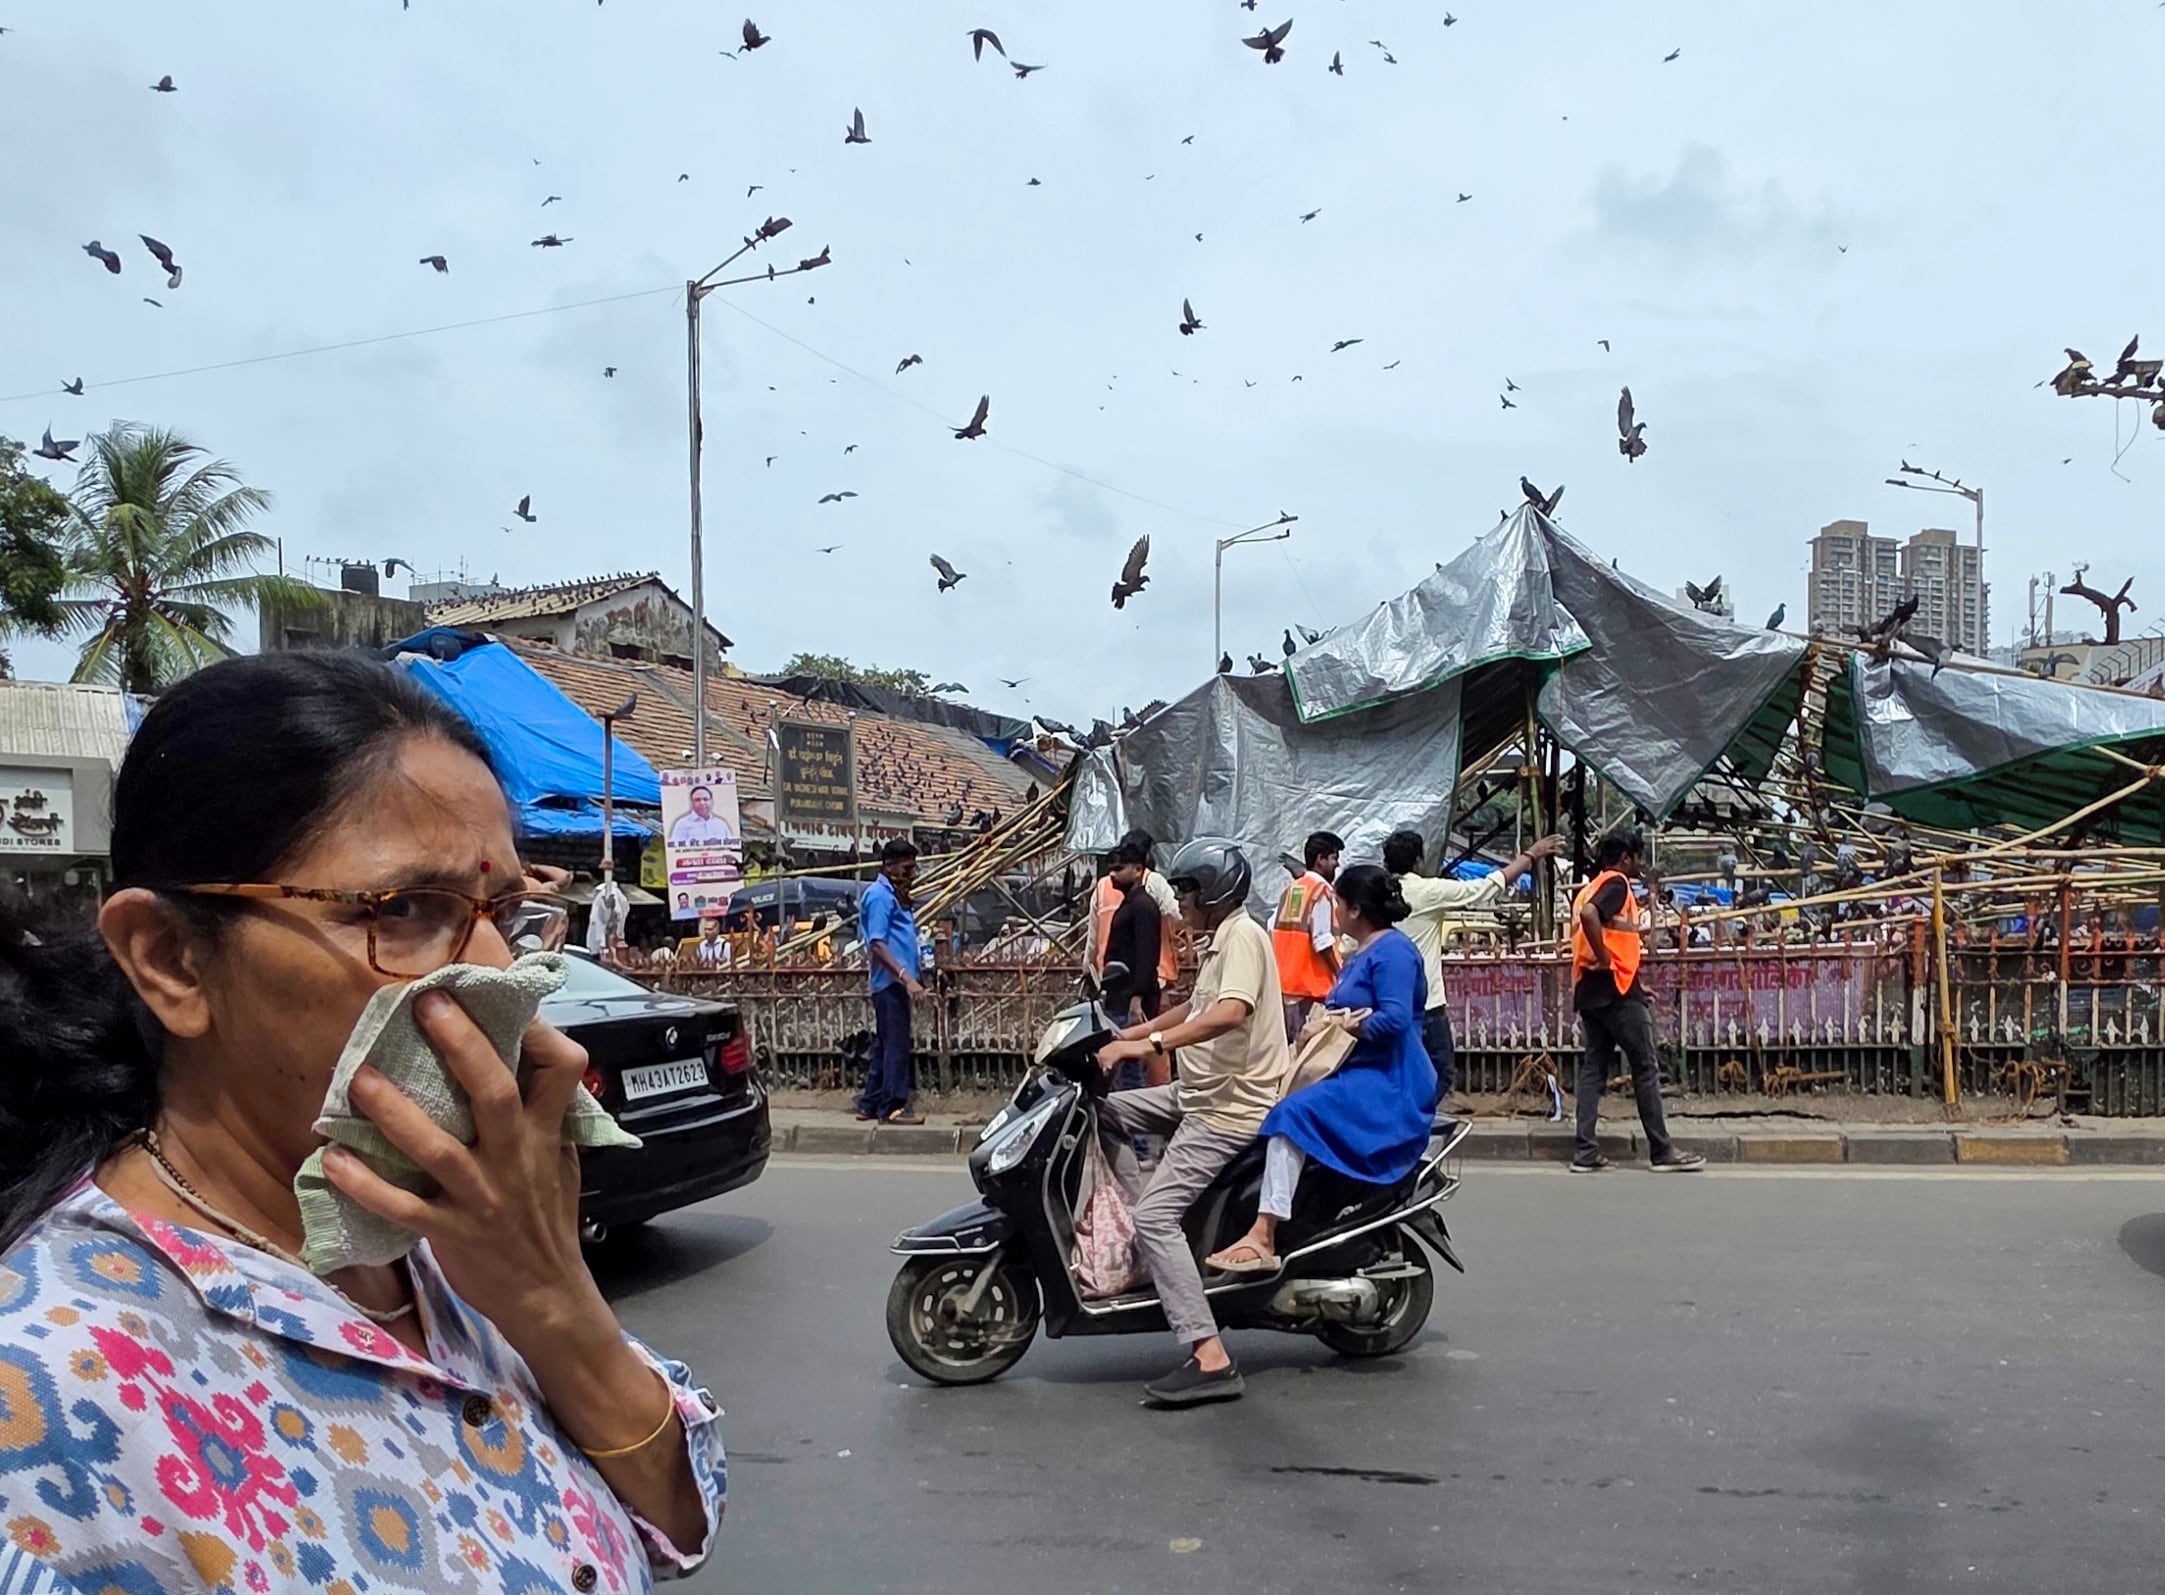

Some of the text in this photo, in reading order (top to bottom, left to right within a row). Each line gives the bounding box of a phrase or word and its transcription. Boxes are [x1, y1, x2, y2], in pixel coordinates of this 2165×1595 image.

[17, 837, 61, 846] STORES
[751, 893, 775, 904] POLICE
[631, 1062, 705, 1093] MH43AT2623
